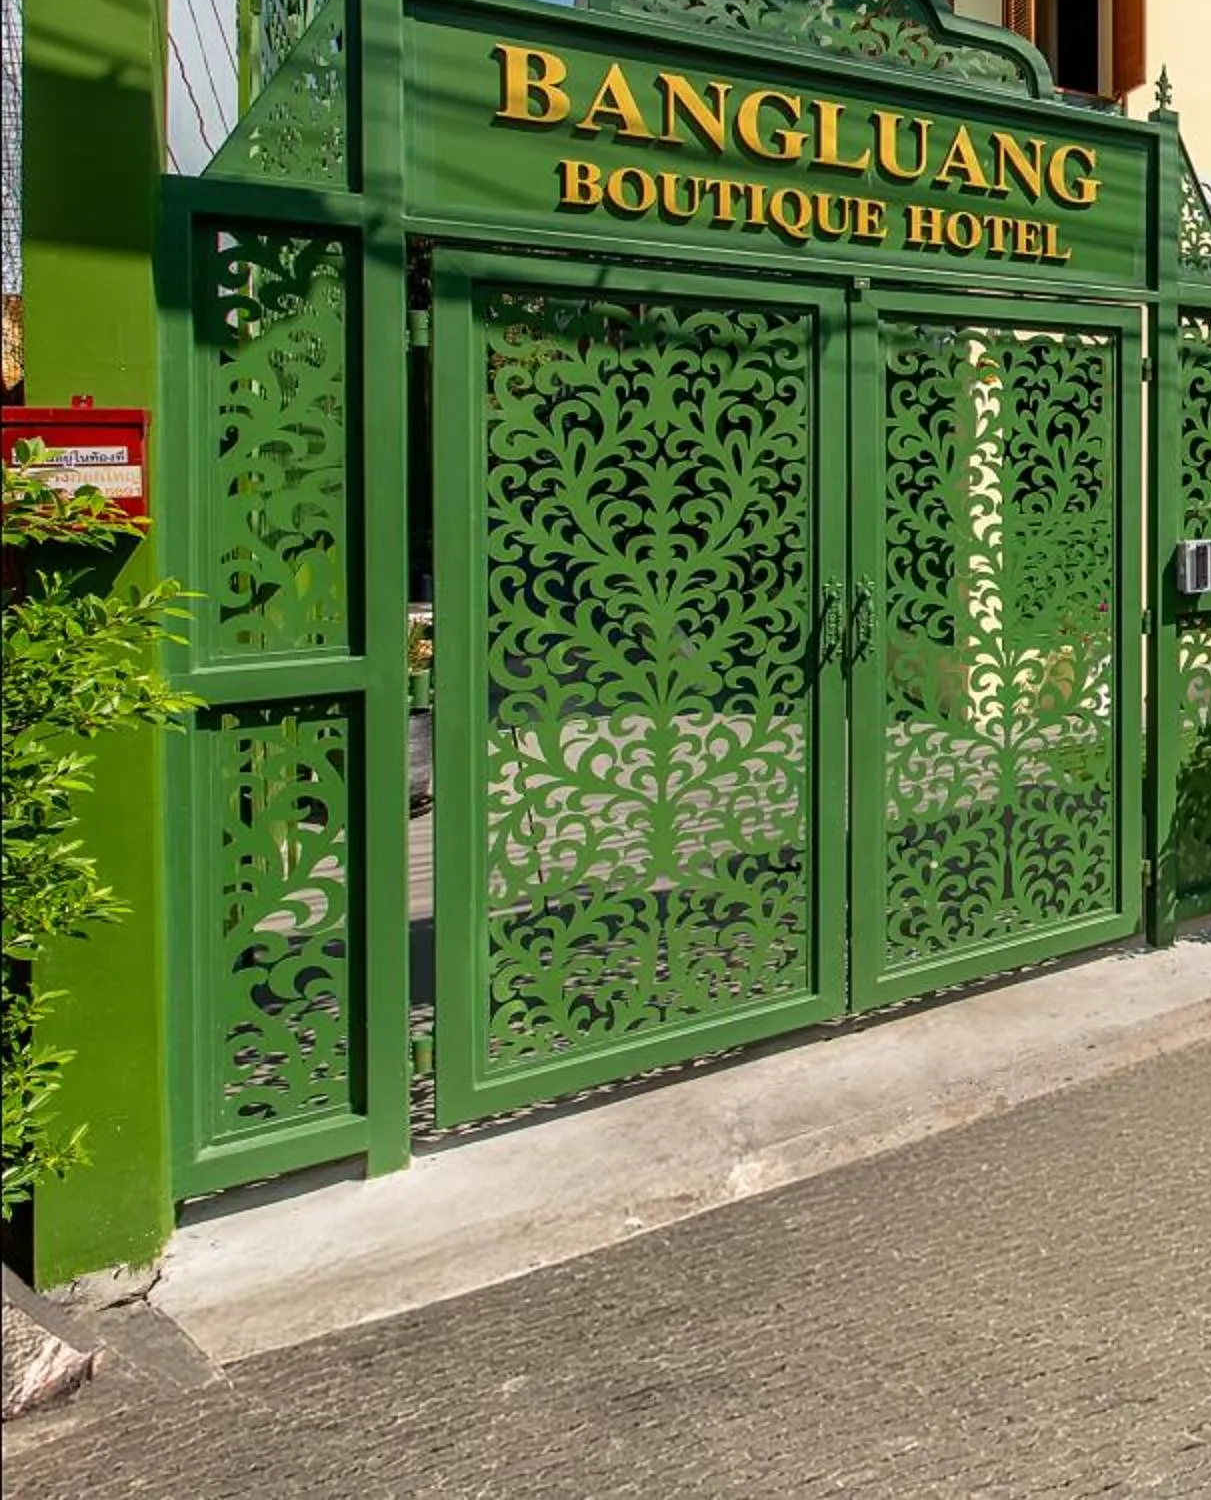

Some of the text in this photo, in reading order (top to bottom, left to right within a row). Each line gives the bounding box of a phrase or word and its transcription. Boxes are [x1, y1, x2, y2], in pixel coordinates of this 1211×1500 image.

[494, 43, 1101, 206] BANGLUANG
[559, 159, 1073, 260] BOUTIQUE HOTEL
